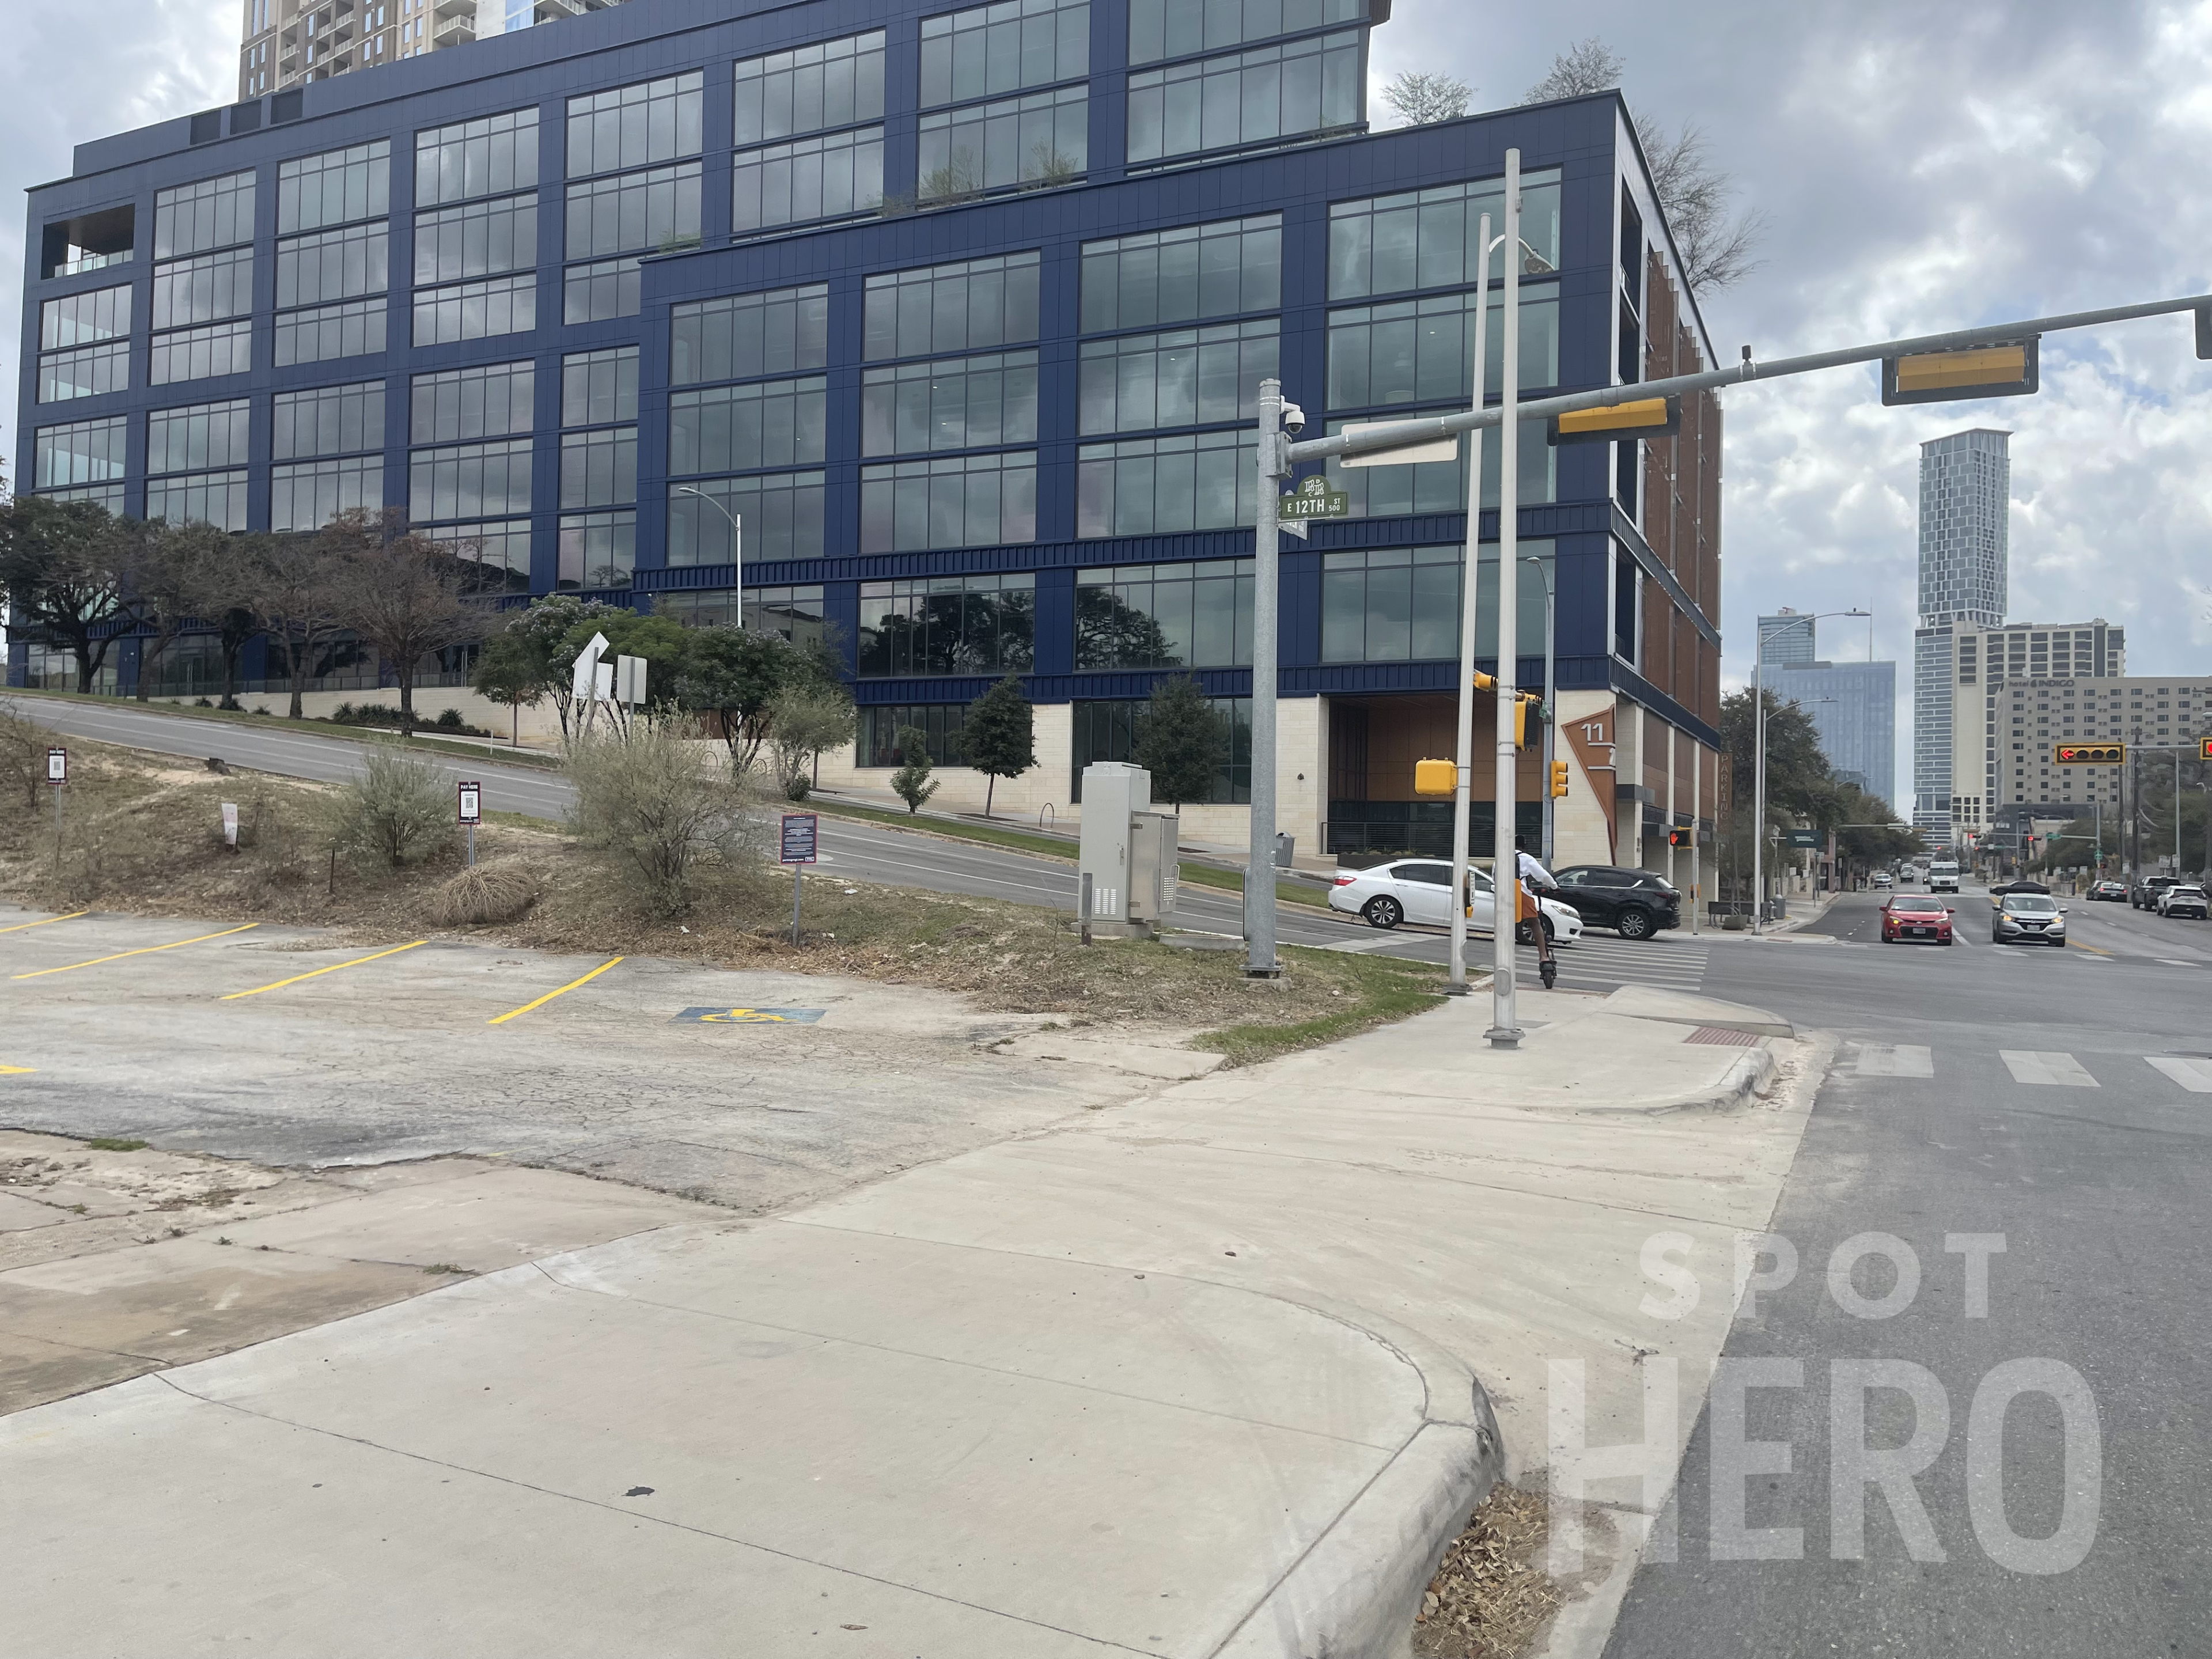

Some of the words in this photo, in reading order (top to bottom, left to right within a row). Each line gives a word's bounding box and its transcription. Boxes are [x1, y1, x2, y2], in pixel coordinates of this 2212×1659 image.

[1287, 503, 1292, 513] E
[1296, 499, 1325, 514] 12TH
[2039, 679, 2074, 687] INDIGO
[1581, 723, 1603, 741] 11
[1720, 755, 1729, 820] PARKING
